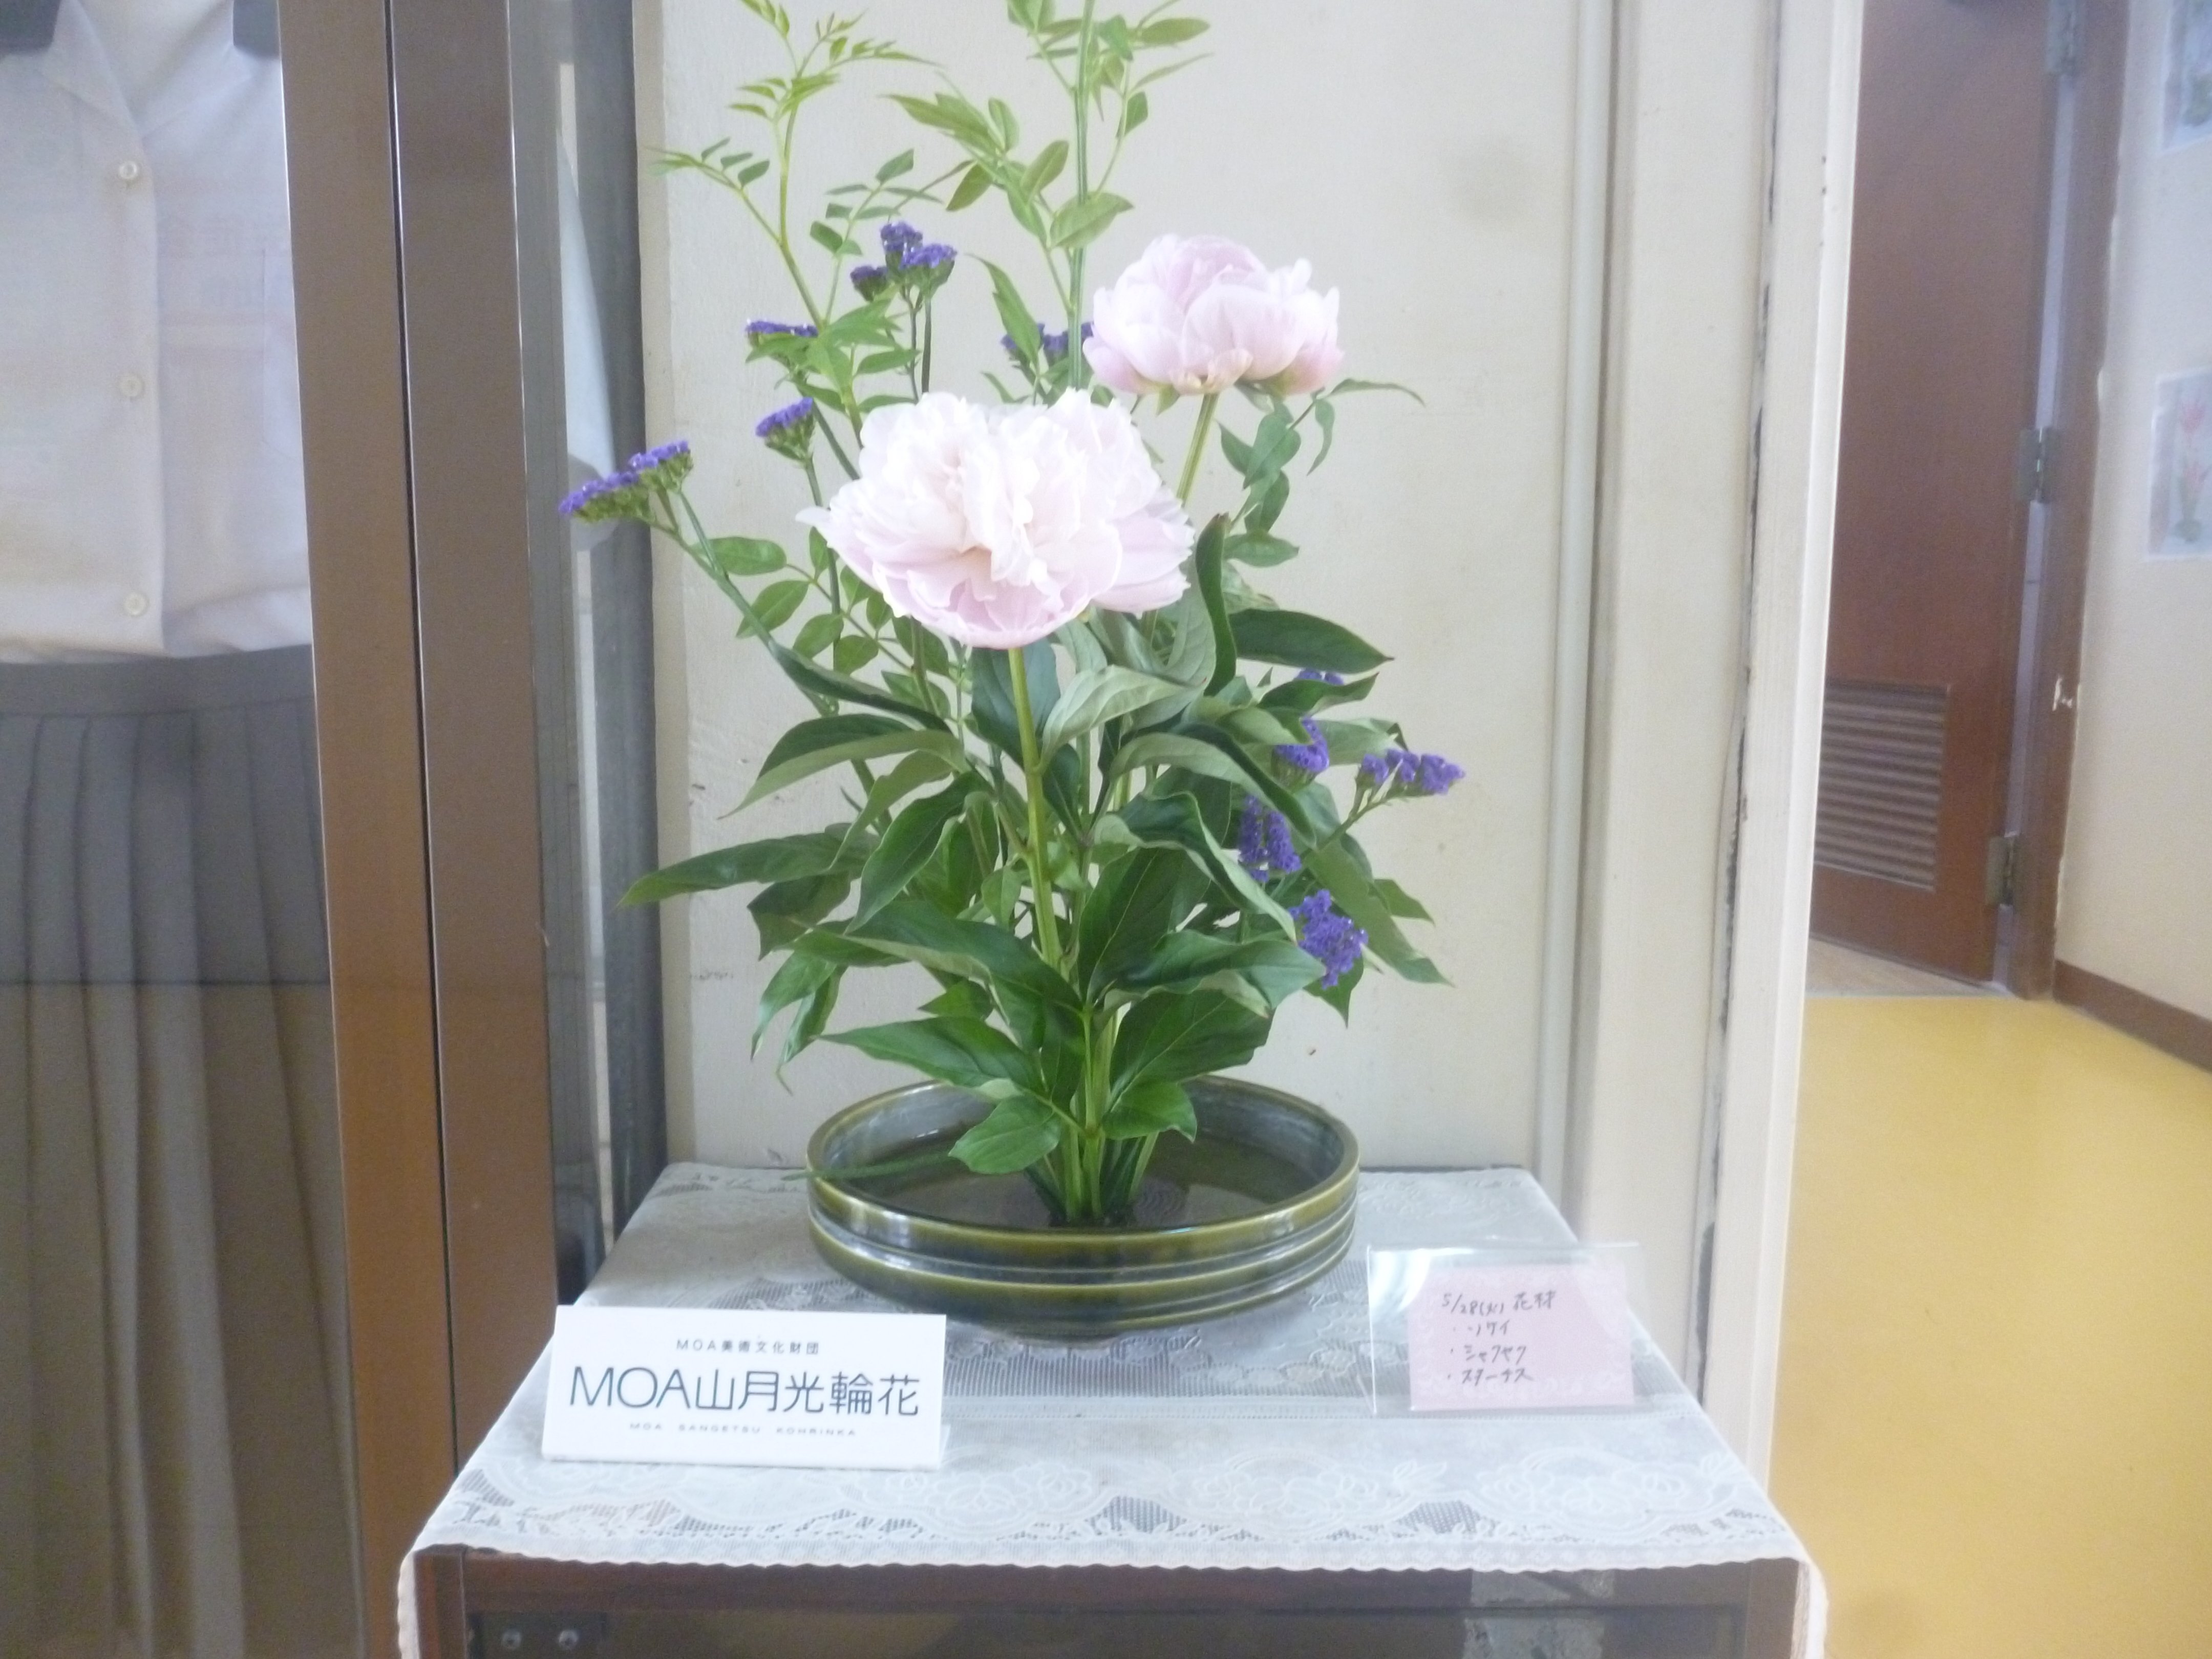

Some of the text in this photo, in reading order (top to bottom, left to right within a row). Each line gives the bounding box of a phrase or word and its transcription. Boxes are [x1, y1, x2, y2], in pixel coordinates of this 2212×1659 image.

[570, 1366, 920, 1416] MOA山月光輪花
[678, 1424, 761, 1434] SANGETSU
